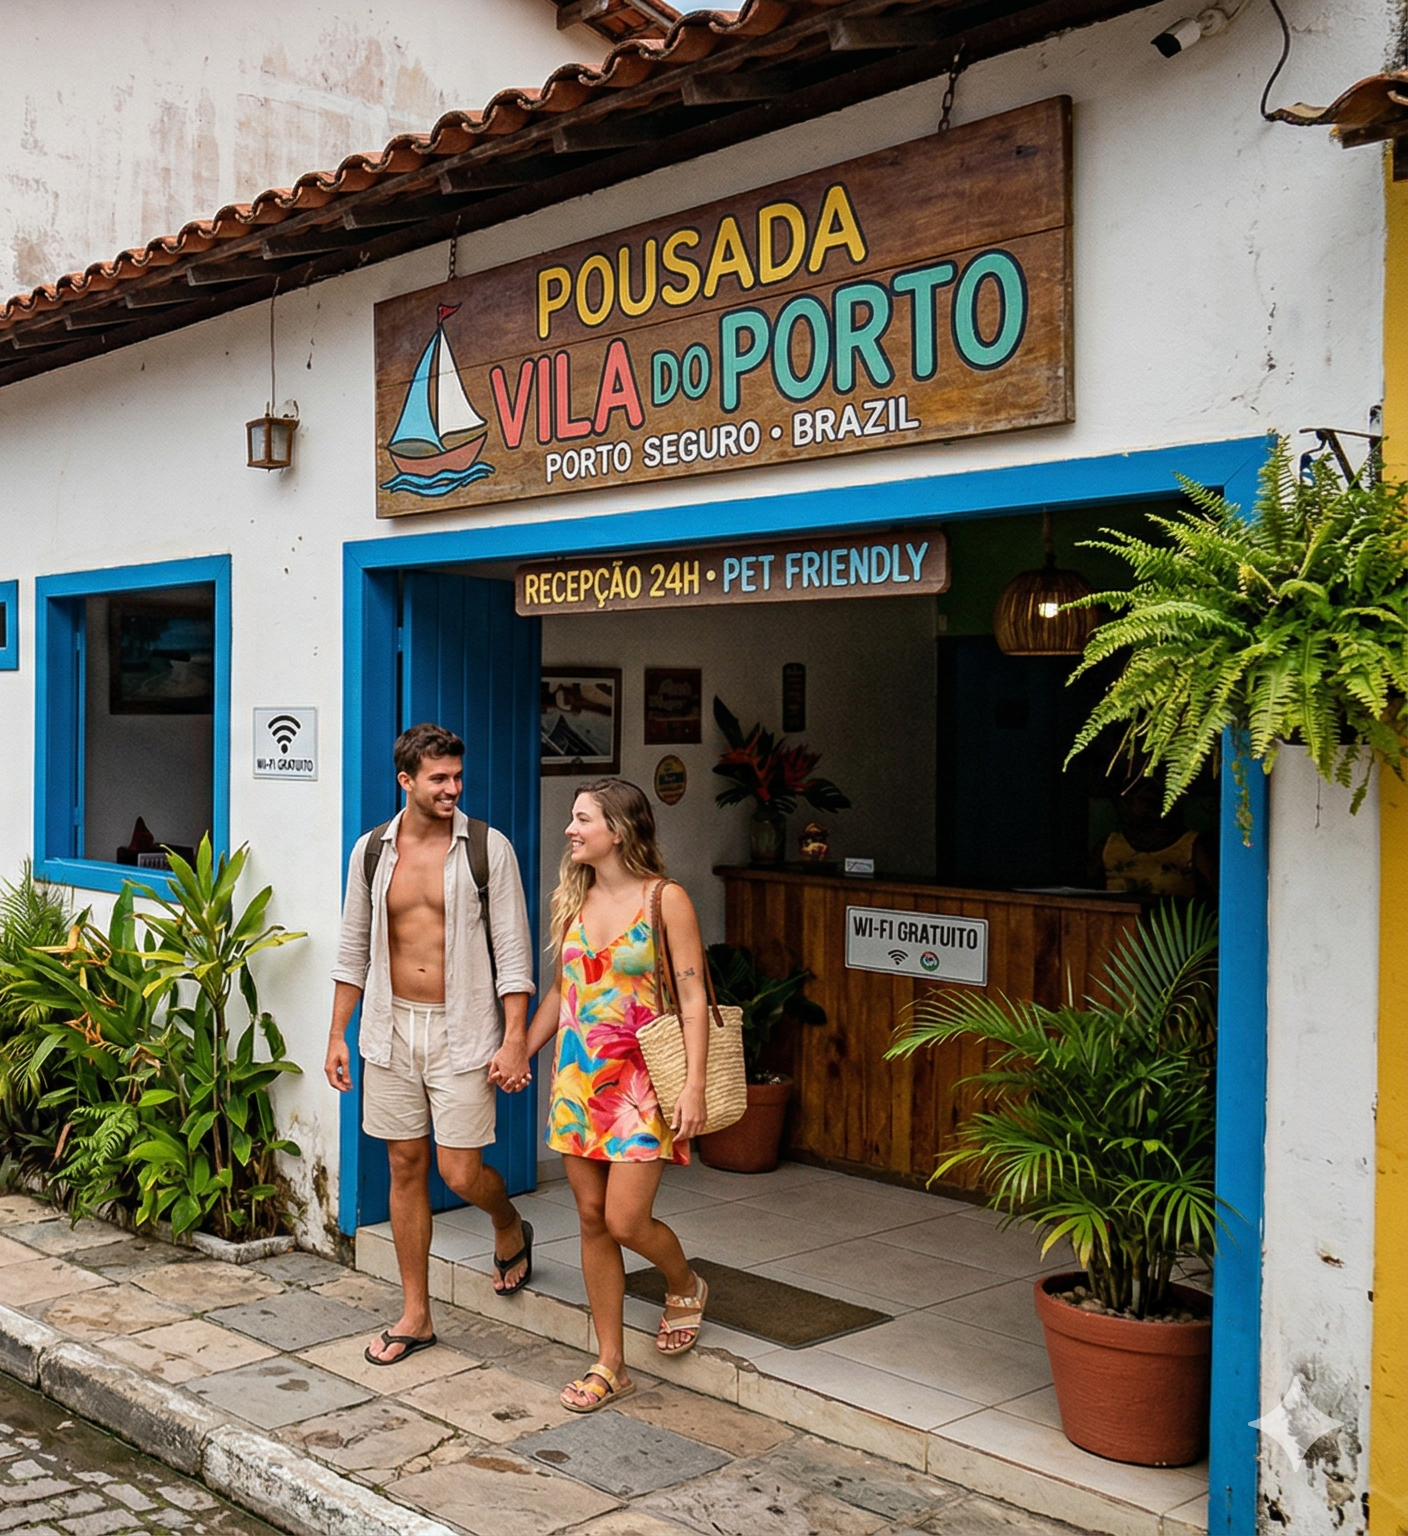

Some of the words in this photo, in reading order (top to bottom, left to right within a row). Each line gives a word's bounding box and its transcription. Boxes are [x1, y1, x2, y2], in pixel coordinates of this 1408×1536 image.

[537, 183, 867, 340] POUSADA
[490, 340, 644, 449] VILA
[652, 344, 710, 406] DO
[720, 250, 1027, 413] PORTO
[546, 444, 632, 484] PORTO
[643, 419, 761, 469] SEGURO
[792, 396, 921, 447] BRAZIL
[524, 560, 642, 608] RECEPÇÃO
[650, 560, 700, 599] 24H
[722, 555, 776, 593] PET
[785, 541, 930, 590] FRIENDLY
[853, 916, 893, 940] WI-FI
[897, 921, 978, 950] GRATUITO
